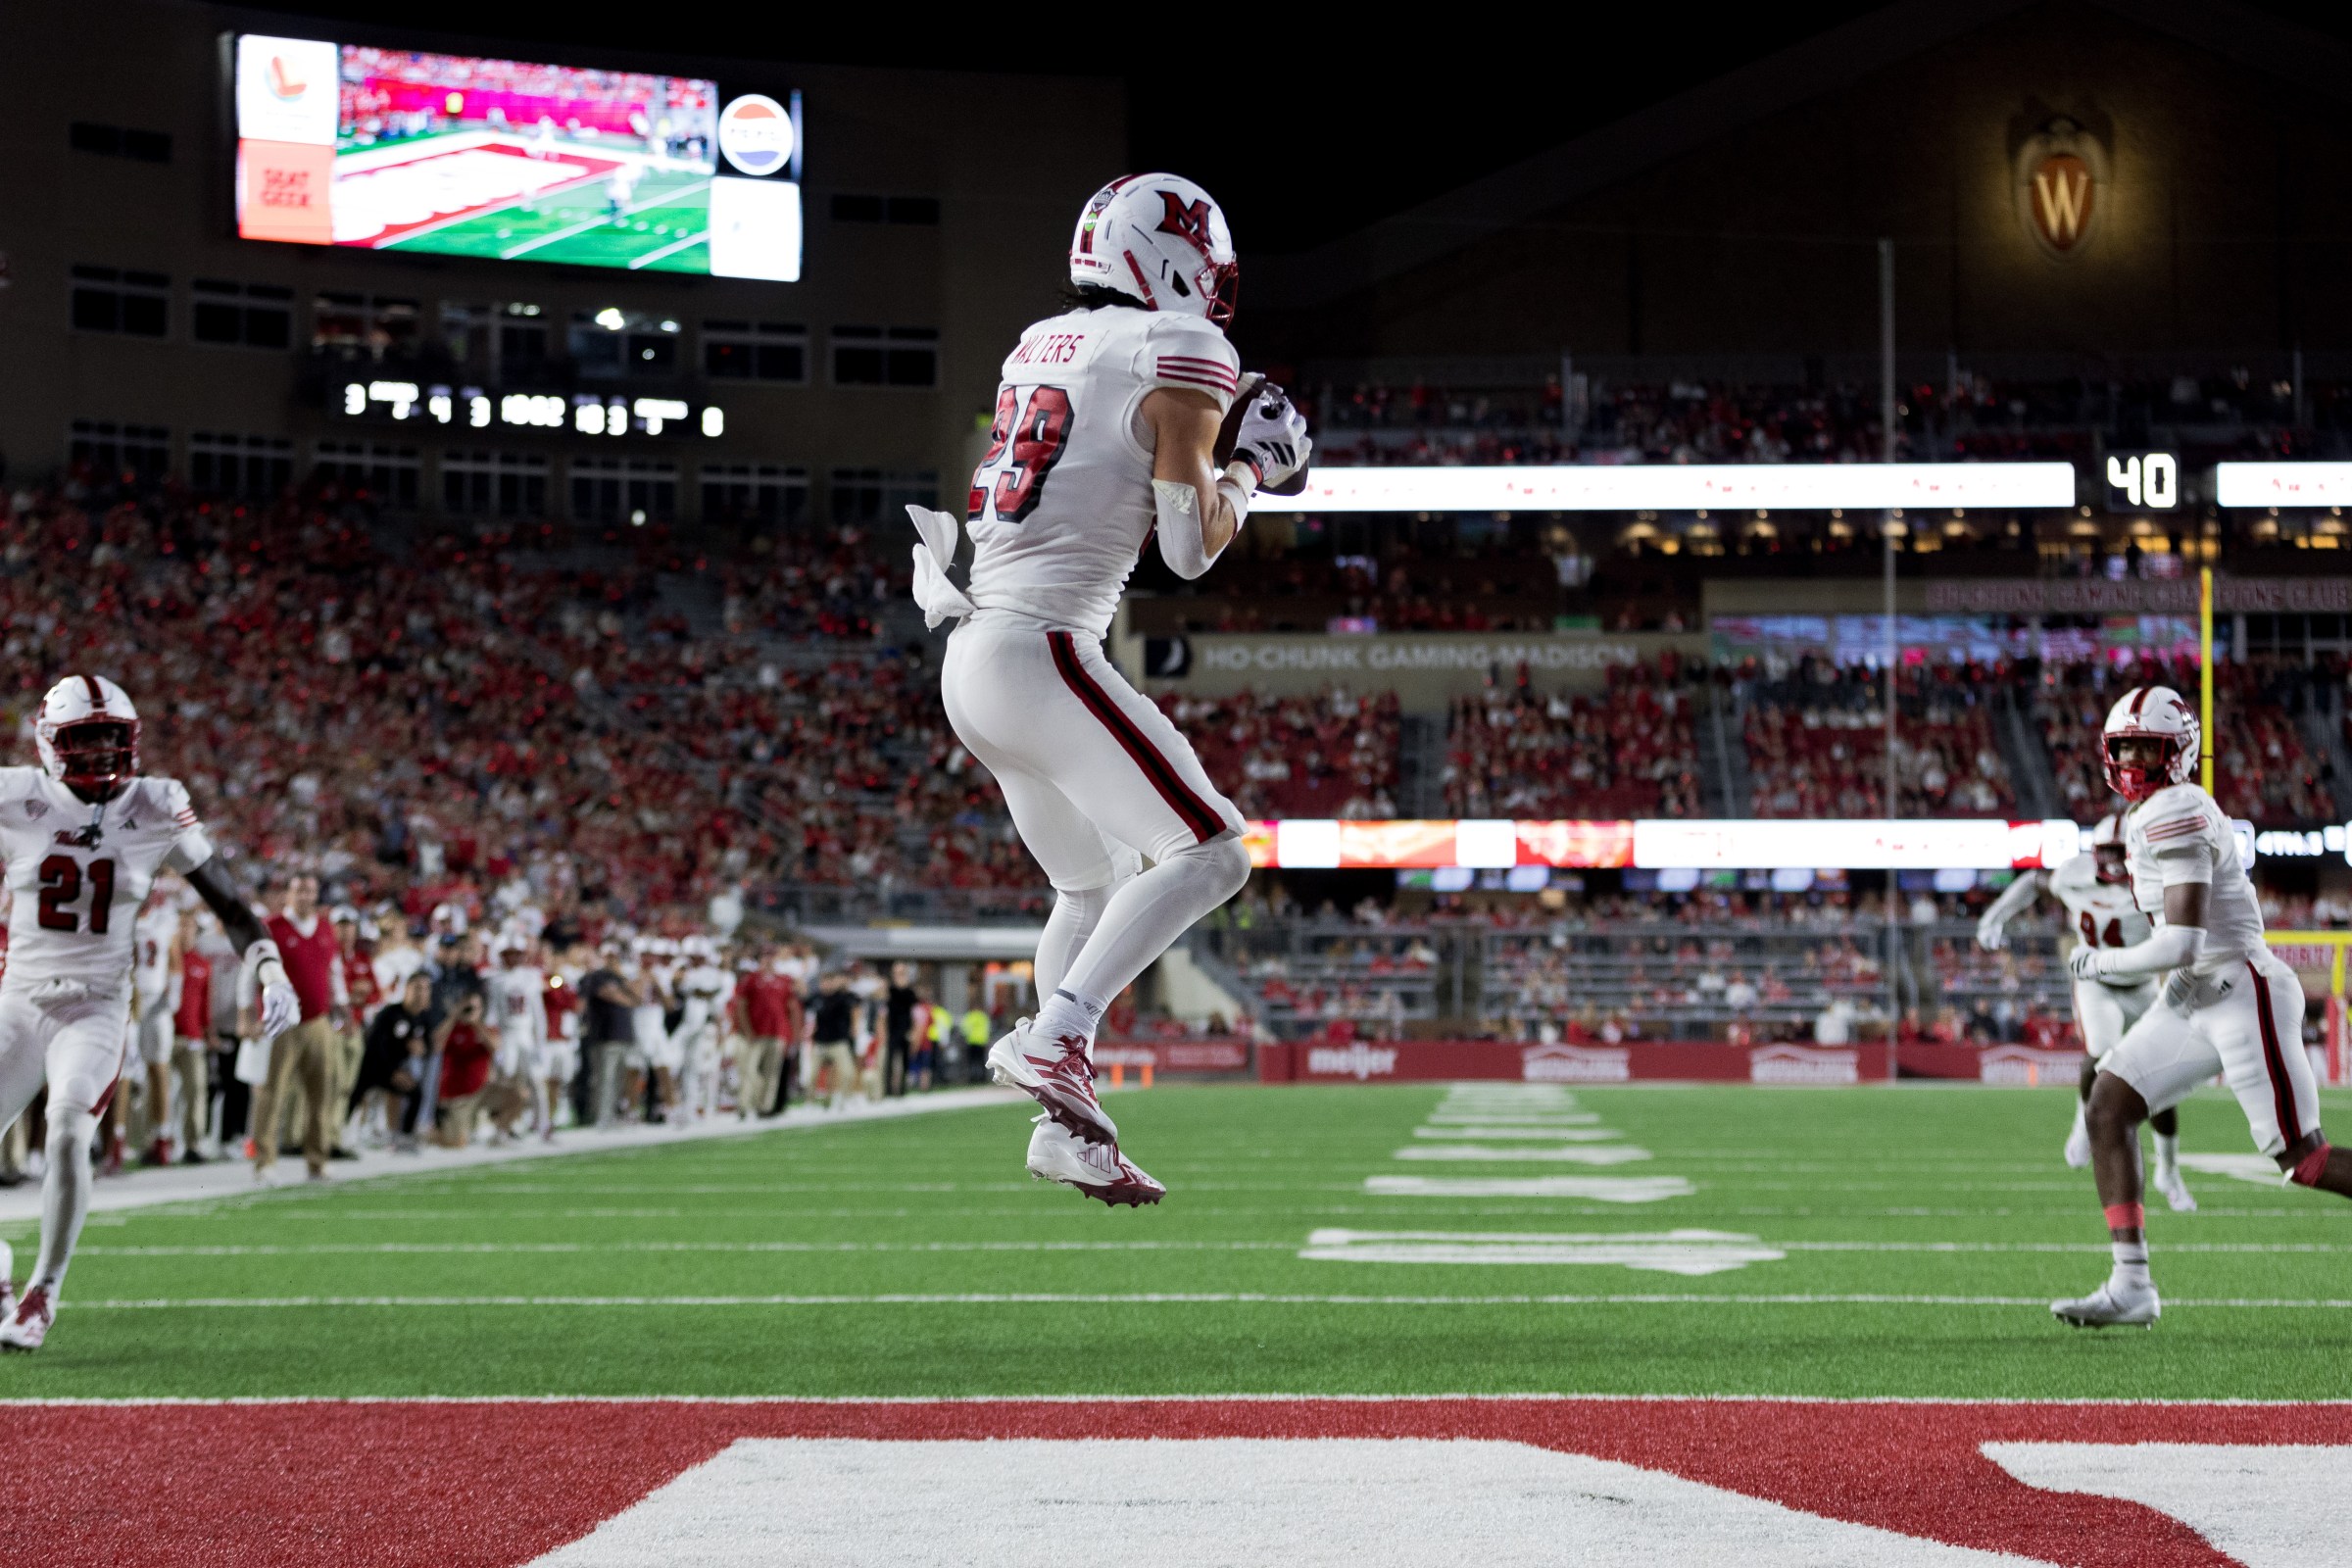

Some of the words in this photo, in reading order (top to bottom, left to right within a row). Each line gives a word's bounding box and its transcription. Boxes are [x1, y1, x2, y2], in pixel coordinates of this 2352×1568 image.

[1154, 190, 1213, 247] M
[2034, 167, 2088, 238] W
[967, 384, 1074, 523] 29
[2107, 454, 2177, 508] 40
[1204, 644, 1361, 668] HO-CHUNK
[1370, 643, 1491, 668] GAMING
[38, 854, 114, 934] 21
